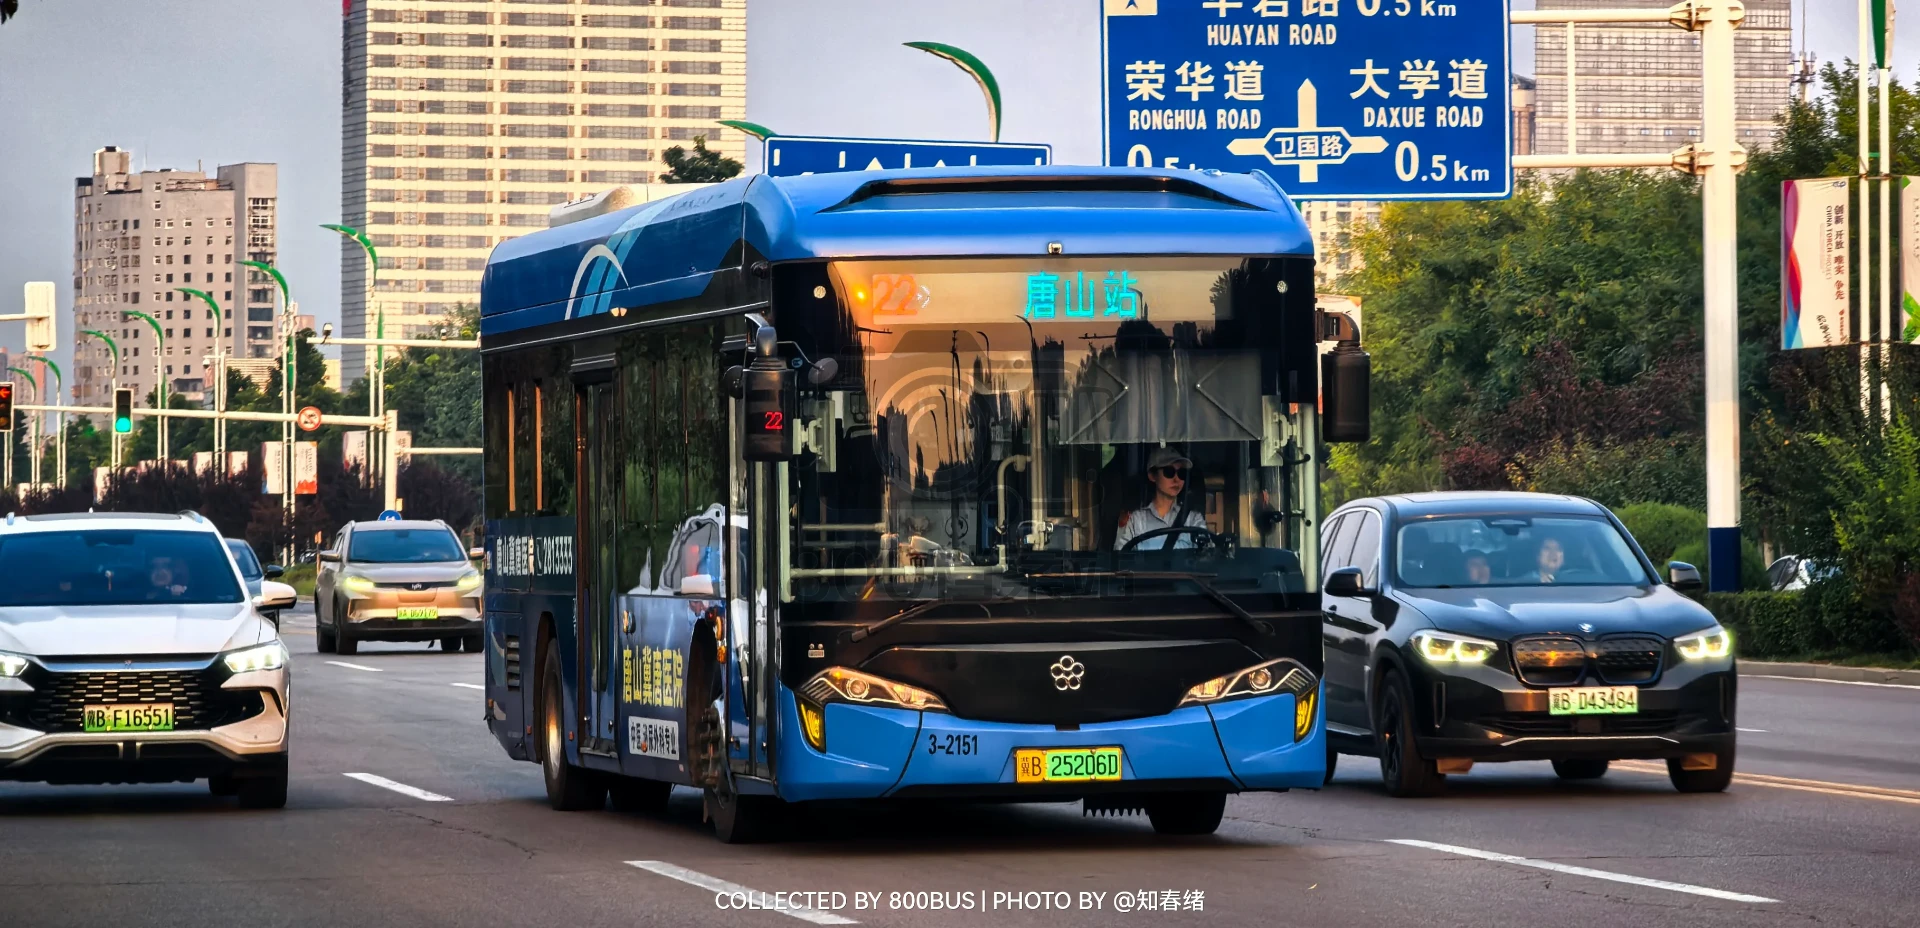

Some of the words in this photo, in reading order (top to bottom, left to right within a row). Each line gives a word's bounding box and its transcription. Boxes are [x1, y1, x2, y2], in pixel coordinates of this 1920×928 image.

[1207, 24, 1279, 46] HUAYAN
[1289, 24, 1337, 46] ROAD
[1125, 60, 1265, 102] 荣华道
[1350, 58, 1489, 100] 大学道
[1129, 109, 1207, 131] RONGHUA
[1216, 108, 1262, 130] ROAD
[1363, 106, 1426, 128] DAXUE
[1436, 106, 1484, 128] ROAD
[1274, 135, 1344, 158] 卫国路
[1395, 140, 1448, 182] 0.5
[1453, 160, 1490, 182] km
[872, 274, 918, 316] 22
[1024, 270, 1137, 319] 唐山站
[764, 411, 783, 430] 22
[543, 535, 573, 575] 2813333
[622, 644, 683, 709] 唐山冀唐医院
[928, 733, 978, 756] 3-2151
